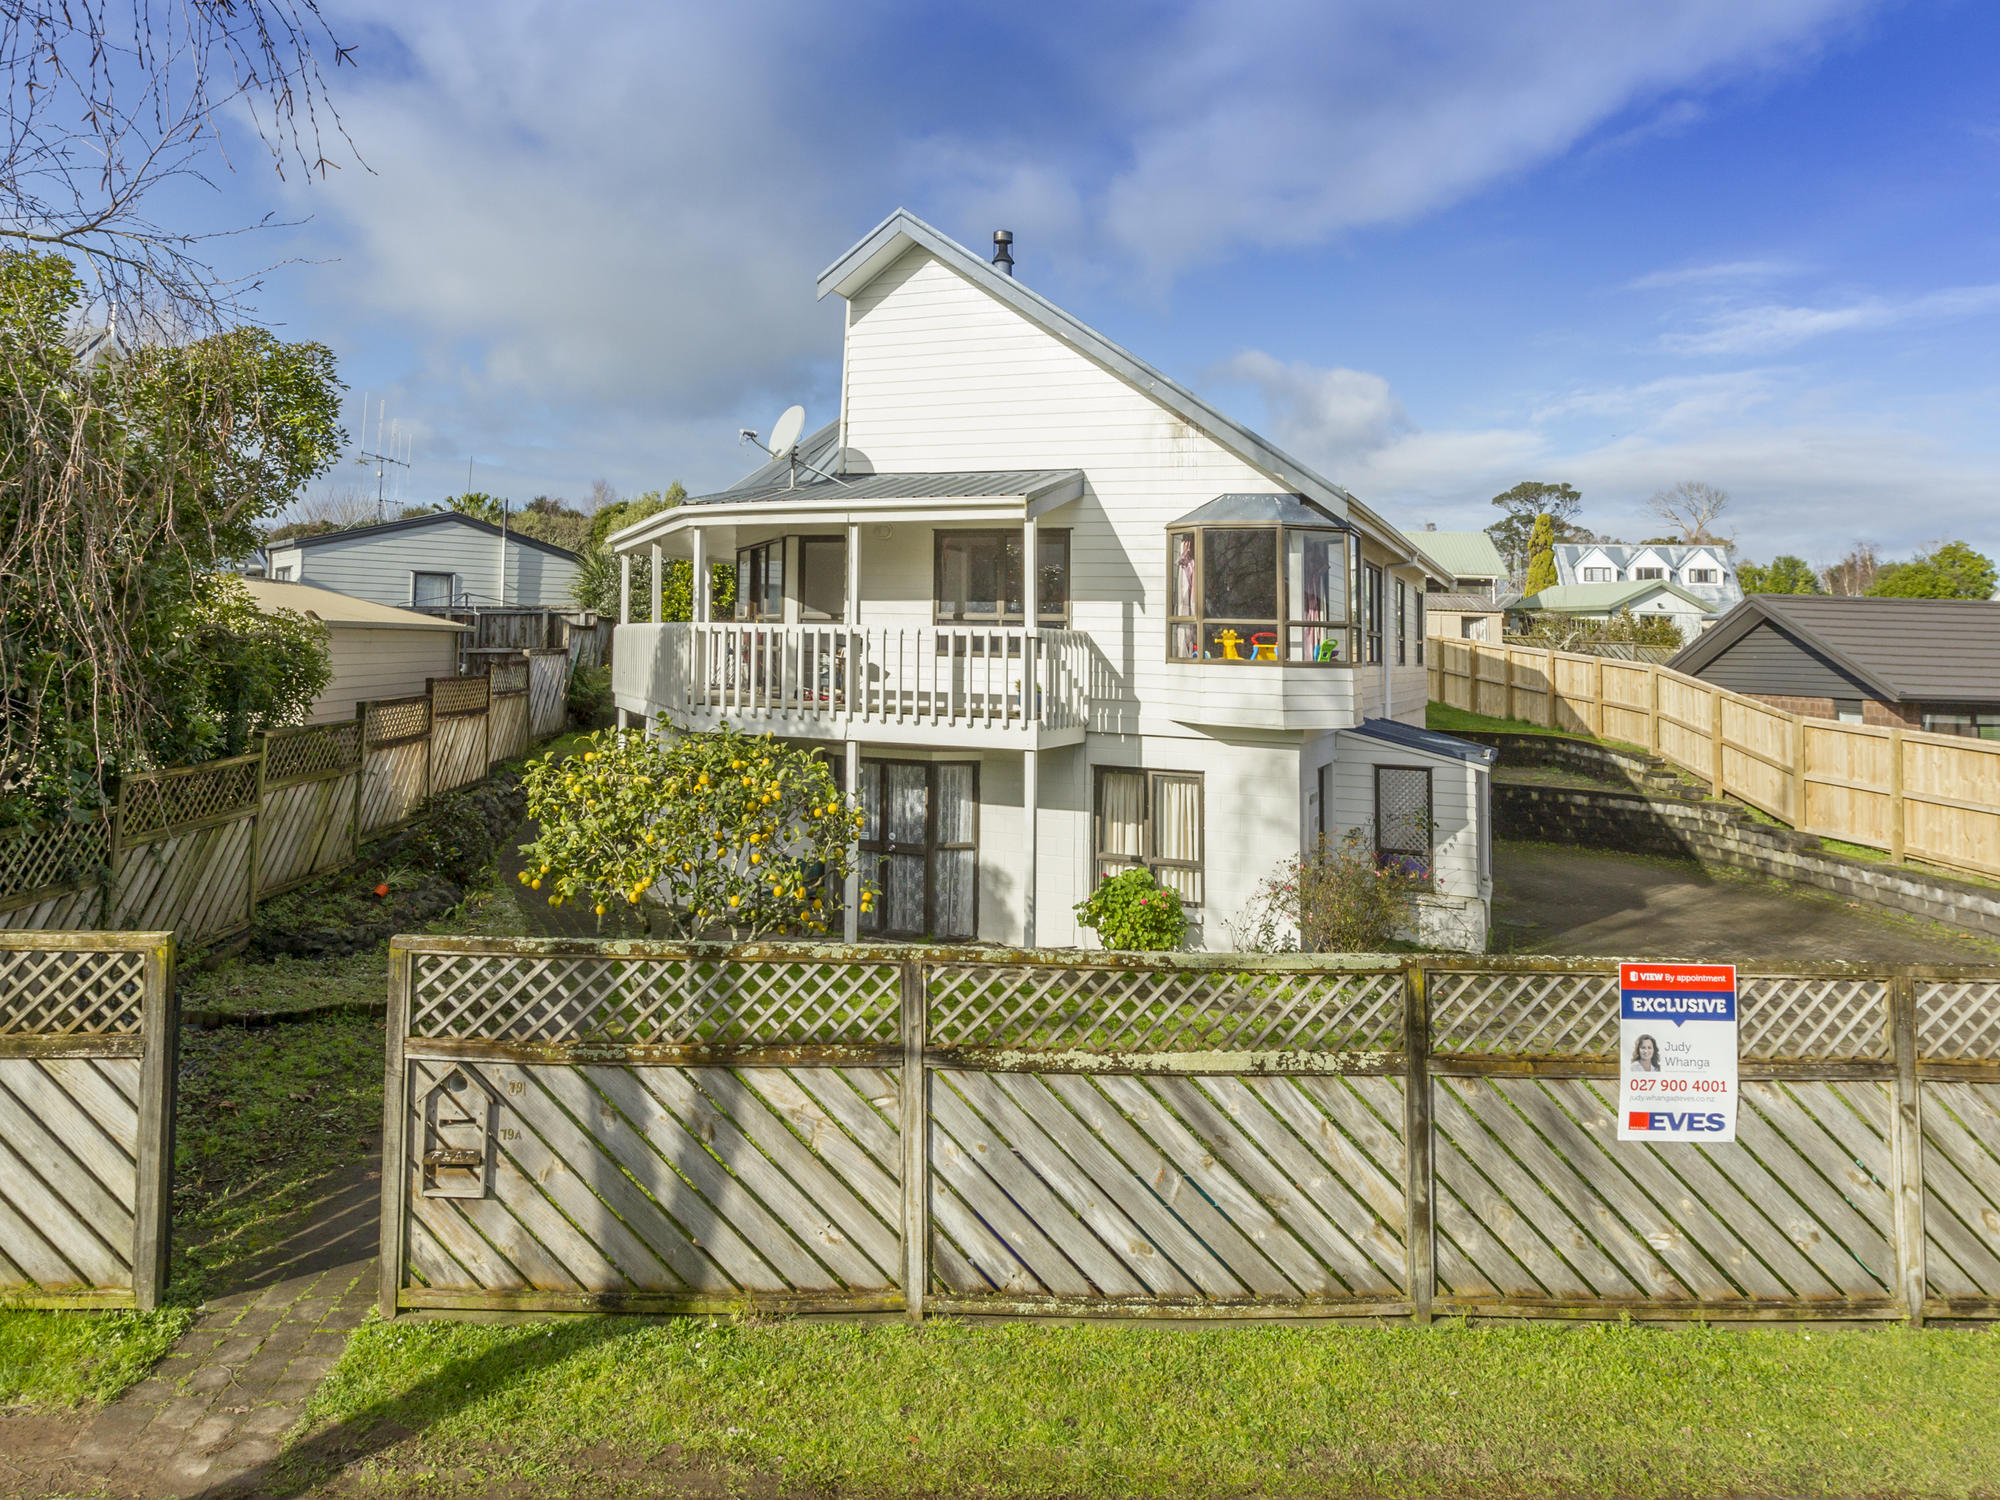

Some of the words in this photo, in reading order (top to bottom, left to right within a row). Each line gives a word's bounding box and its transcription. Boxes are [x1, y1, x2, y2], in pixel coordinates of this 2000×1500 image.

[1640, 972, 1663, 981] VIEW
[1665, 973, 1675, 983] By
[1676, 974, 1726, 983] appointment
[1631, 997, 1727, 1014] EXCLUSIVE
[1664, 1041, 1691, 1054] Judy
[1664, 1057, 1710, 1069] Whanga
[1630, 1079, 1656, 1092] 027
[1660, 1080, 1687, 1092] 900
[1692, 1080, 1728, 1093] 4001
[1649, 1112, 1726, 1132] EVES
